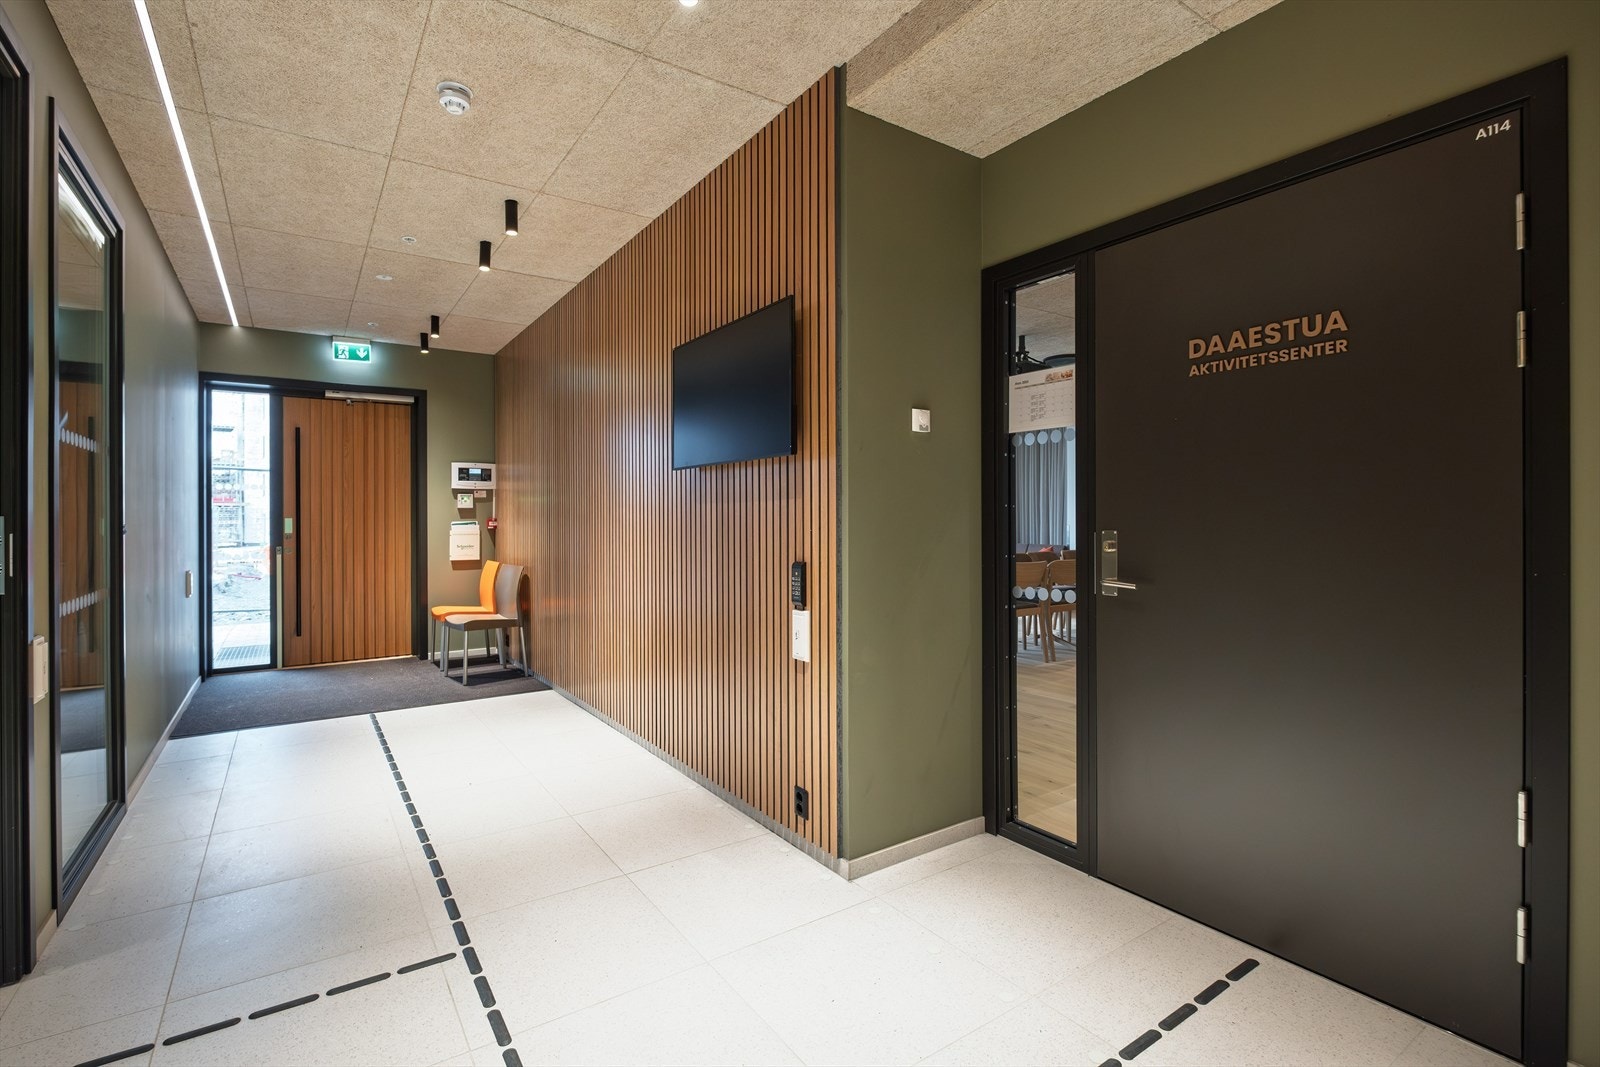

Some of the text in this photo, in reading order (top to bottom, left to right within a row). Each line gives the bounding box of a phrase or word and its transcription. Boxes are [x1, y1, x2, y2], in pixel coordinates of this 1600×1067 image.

[1475, 119, 1511, 141] A114
[1188, 309, 1349, 360] DAAESTUA
[1188, 339, 1348, 377] AKTIVITETSSENTER
